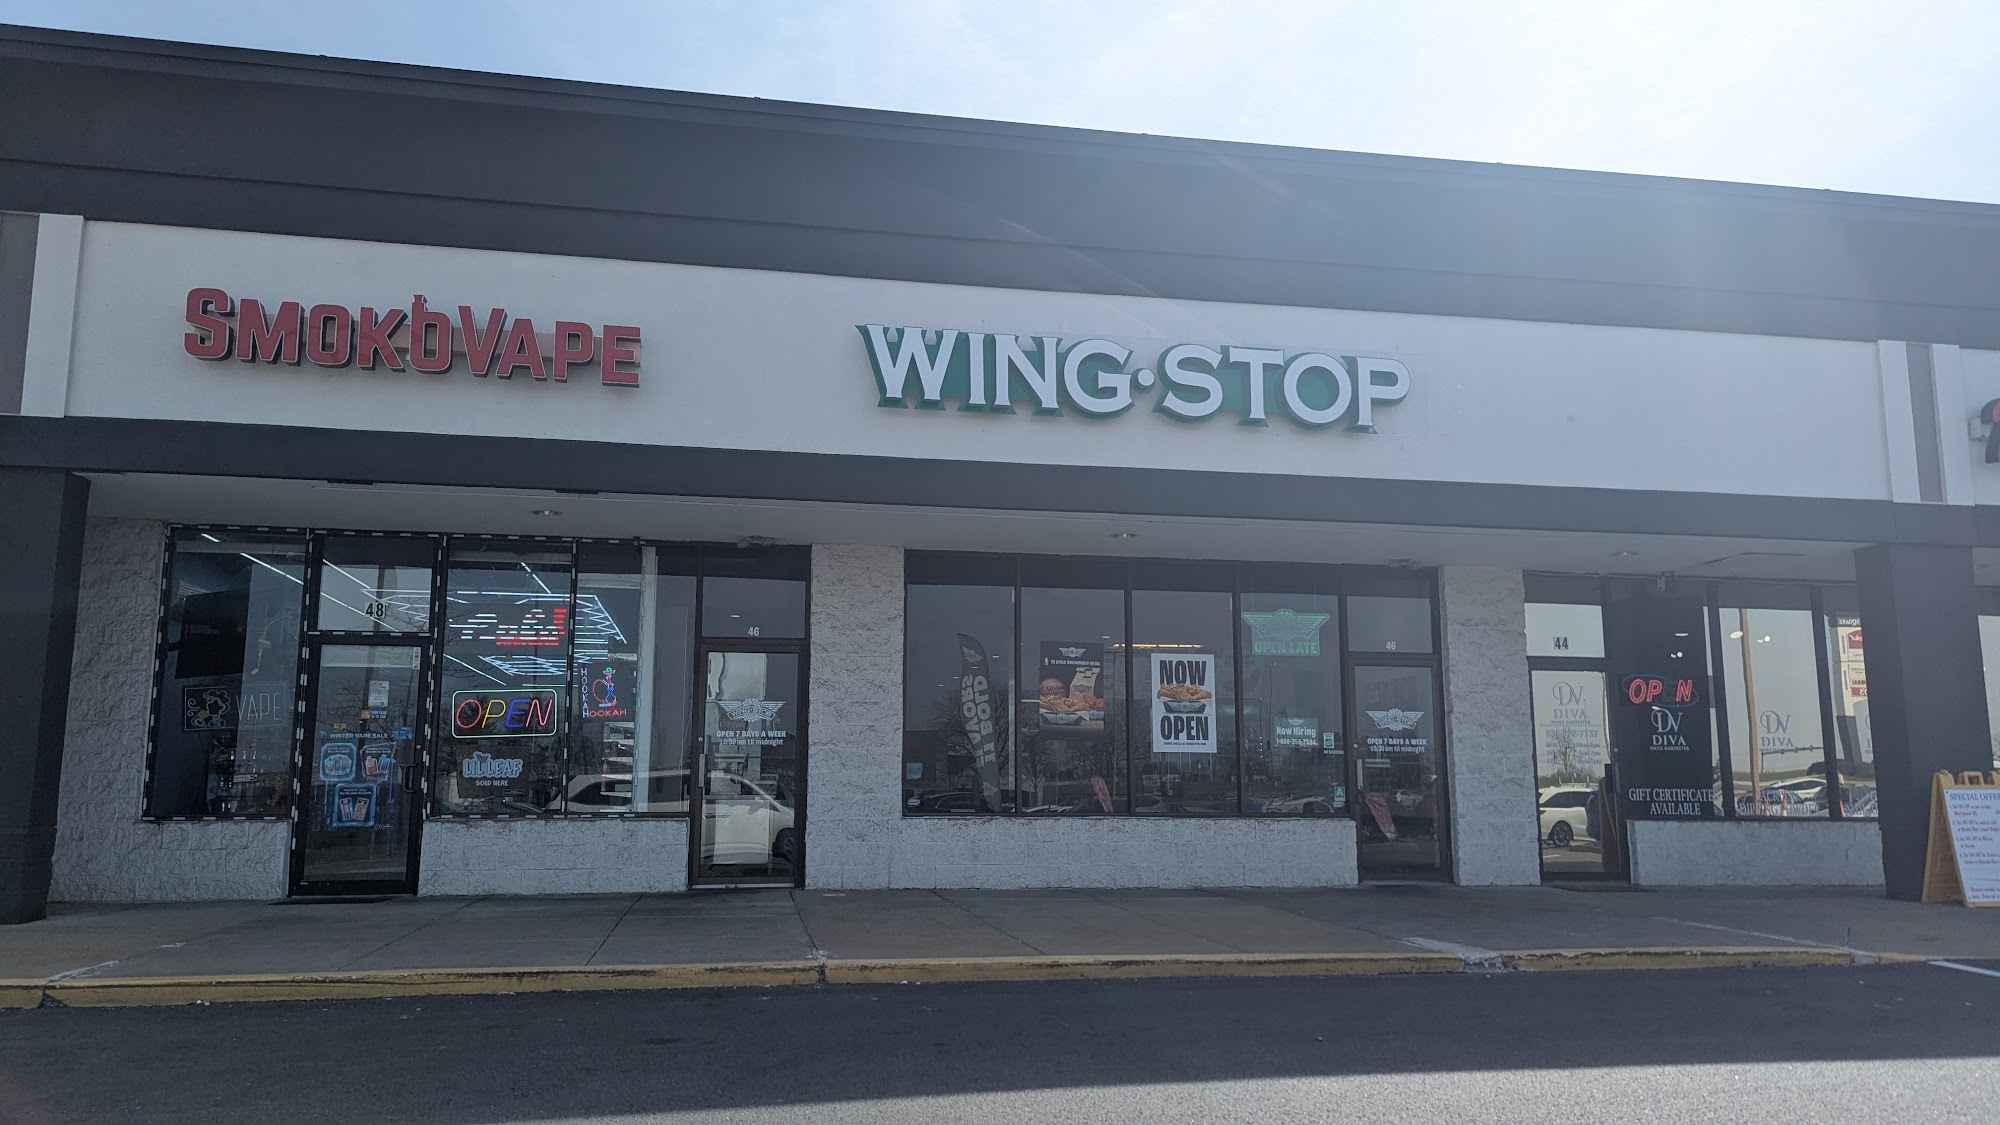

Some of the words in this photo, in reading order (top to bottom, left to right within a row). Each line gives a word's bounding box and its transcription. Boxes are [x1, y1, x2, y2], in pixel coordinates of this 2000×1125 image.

[365, 602, 386, 618] 48
[747, 626, 760, 637] 46
[1254, 641, 1286, 653] OPEN
[1289, 642, 1317, 654] LATE
[1386, 641, 1397, 651] 46
[1553, 637, 1569, 650] 44
[1159, 660, 1207, 686] NOW
[236, 692, 282, 721] VAPE
[456, 698, 553, 729] OPEN
[1553, 708, 1587, 719] DIVA
[1160, 715, 1209, 741] OPEN
[1276, 726, 1292, 735] Now
[1293, 726, 1316, 738] Hiring
[1410, 738, 1427, 746] WEEK
[1652, 734, 1686, 746] DIVA
[1760, 736, 1795, 747] DIVA
[1628, 788, 1651, 801] GIFT
[1949, 793, 1979, 801] SPECIAL
[1650, 802, 1701, 815] AVAILABLE
